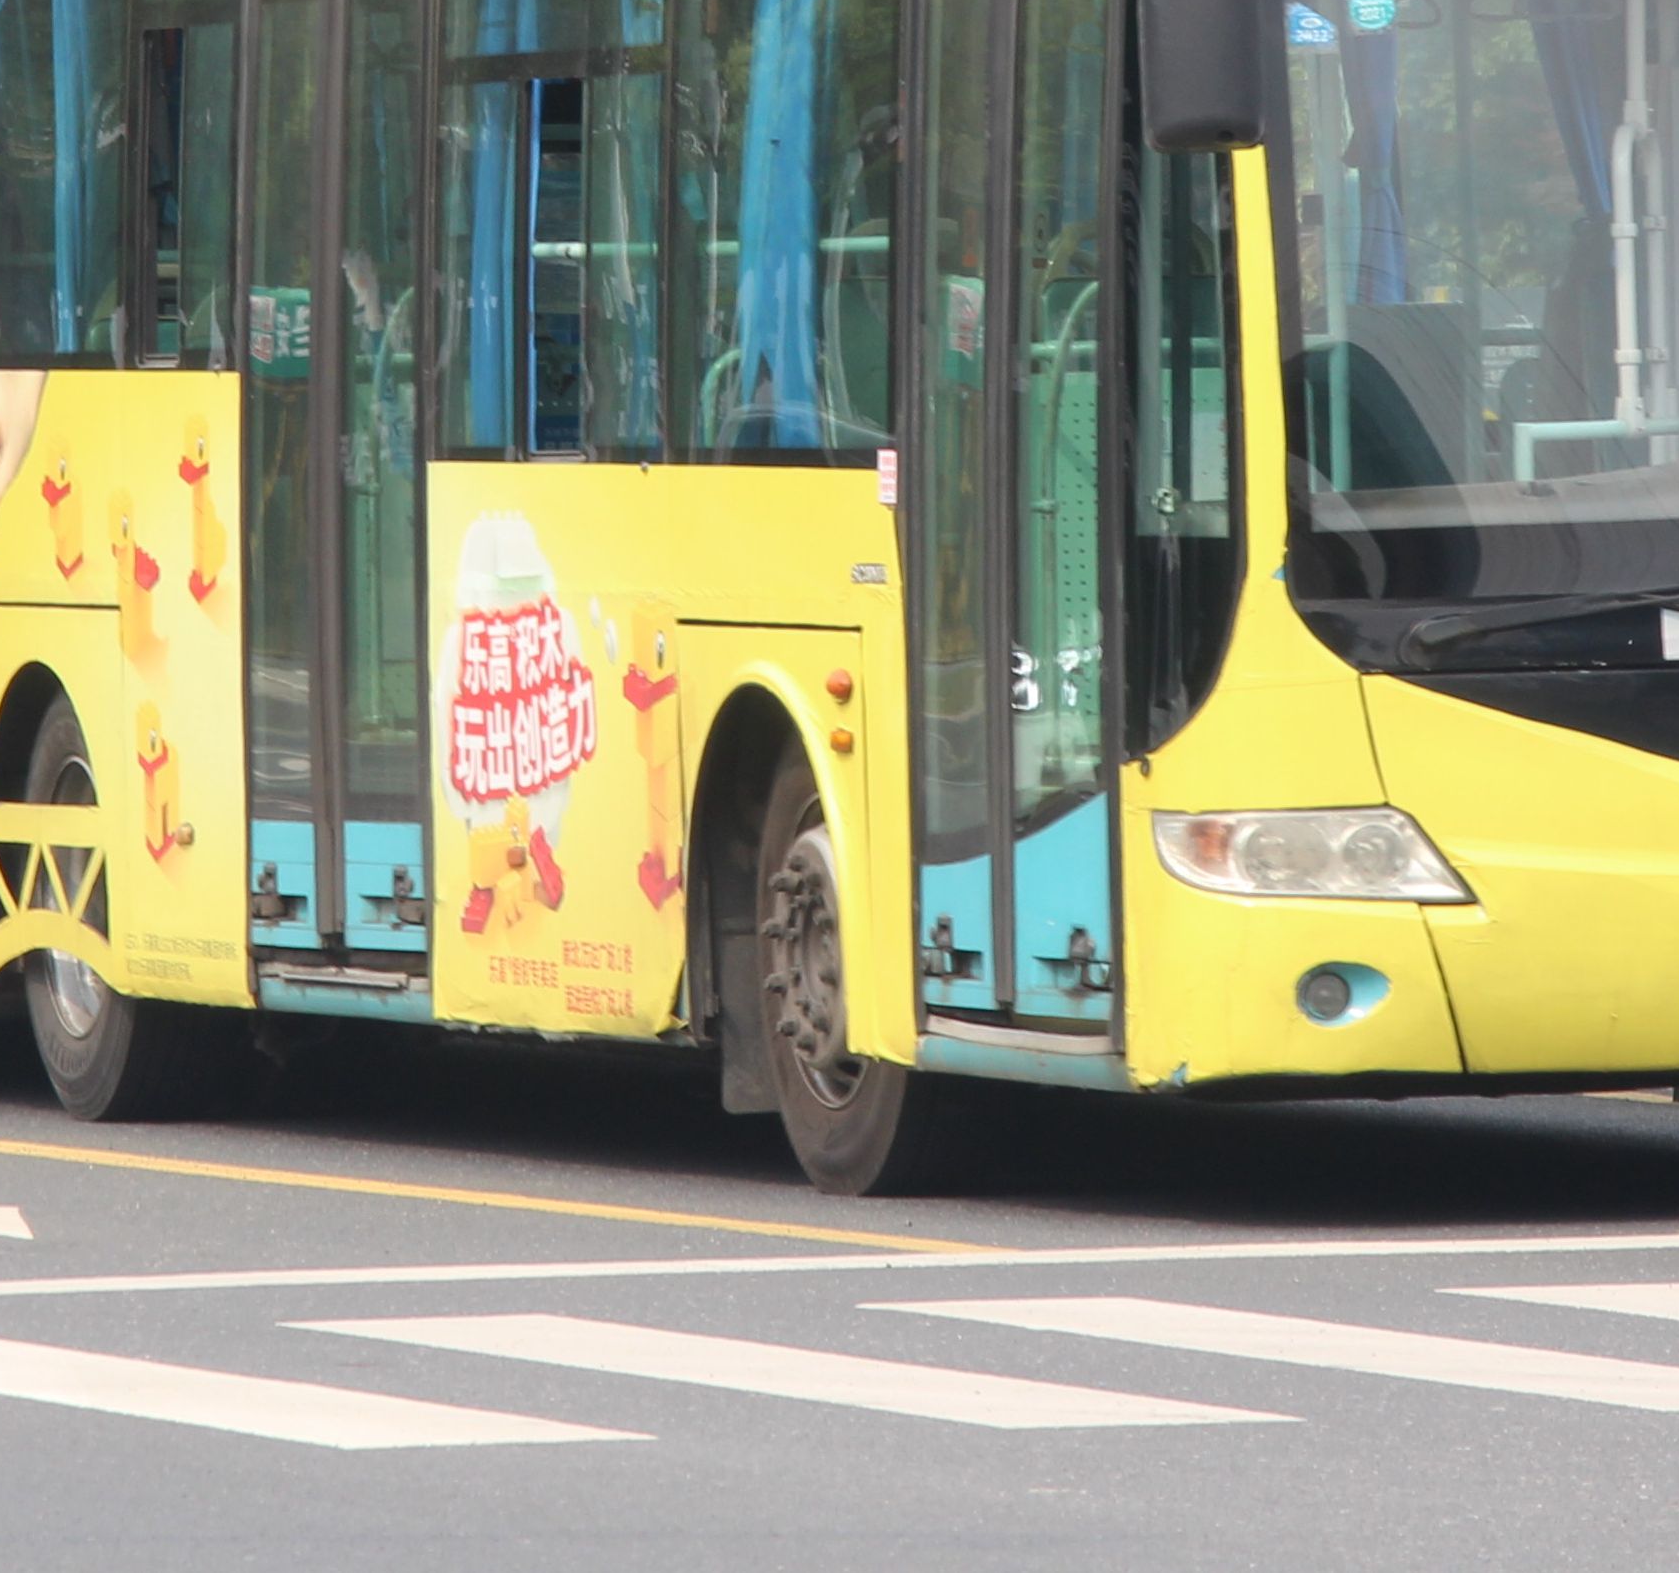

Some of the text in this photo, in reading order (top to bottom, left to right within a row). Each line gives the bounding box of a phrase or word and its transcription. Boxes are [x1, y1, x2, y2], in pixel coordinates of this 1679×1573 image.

[454, 670, 595, 795] 玩出创造力
